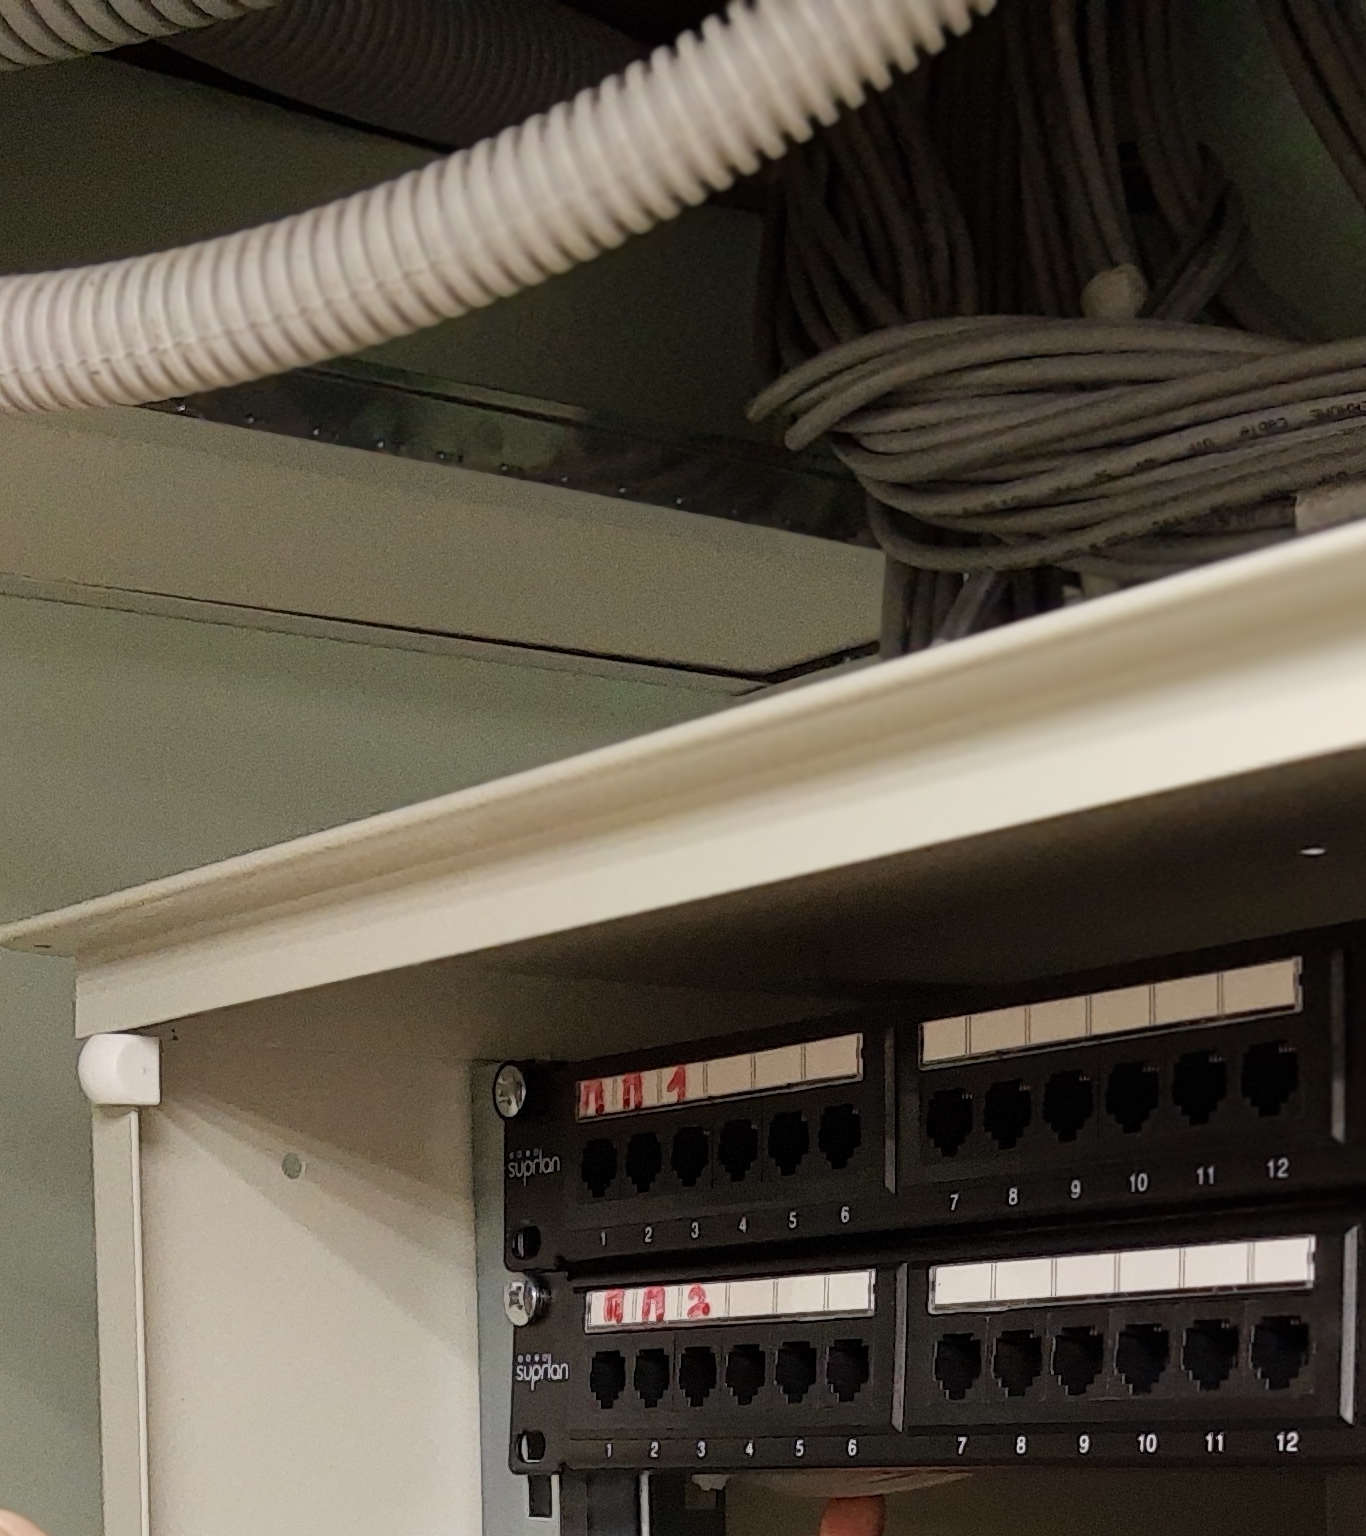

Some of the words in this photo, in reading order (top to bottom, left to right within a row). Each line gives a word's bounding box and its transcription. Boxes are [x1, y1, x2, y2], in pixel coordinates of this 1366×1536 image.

[644, 1226, 653, 1243] 2
[691, 1221, 700, 1239] 3
[738, 1217, 747, 1233] 4
[788, 1211, 797, 1229] 5
[840, 1206, 850, 1224] 6
[950, 1193, 959, 1211] 7
[1008, 1187, 1018, 1206] 8
[1070, 1179, 1081, 1199] 9
[1129, 1172, 1148, 1193] 10
[1196, 1165, 1214, 1185] 11
[1267, 1157, 1289, 1178] 12
[650, 1441, 659, 1458] 2
[697, 1440, 706, 1458] 3
[745, 1440, 754, 1457] 4
[795, 1439, 804, 1457] 5
[847, 1438, 857, 1457] 6
[957, 1436, 968, 1455] 7
[1016, 1436, 1027, 1454] 8
[1078, 1434, 1090, 1454] 9
[1137, 1433, 1158, 1453] 10
[1205, 1432, 1224, 1453] 11
[1276, 1431, 1299, 1452] 12
